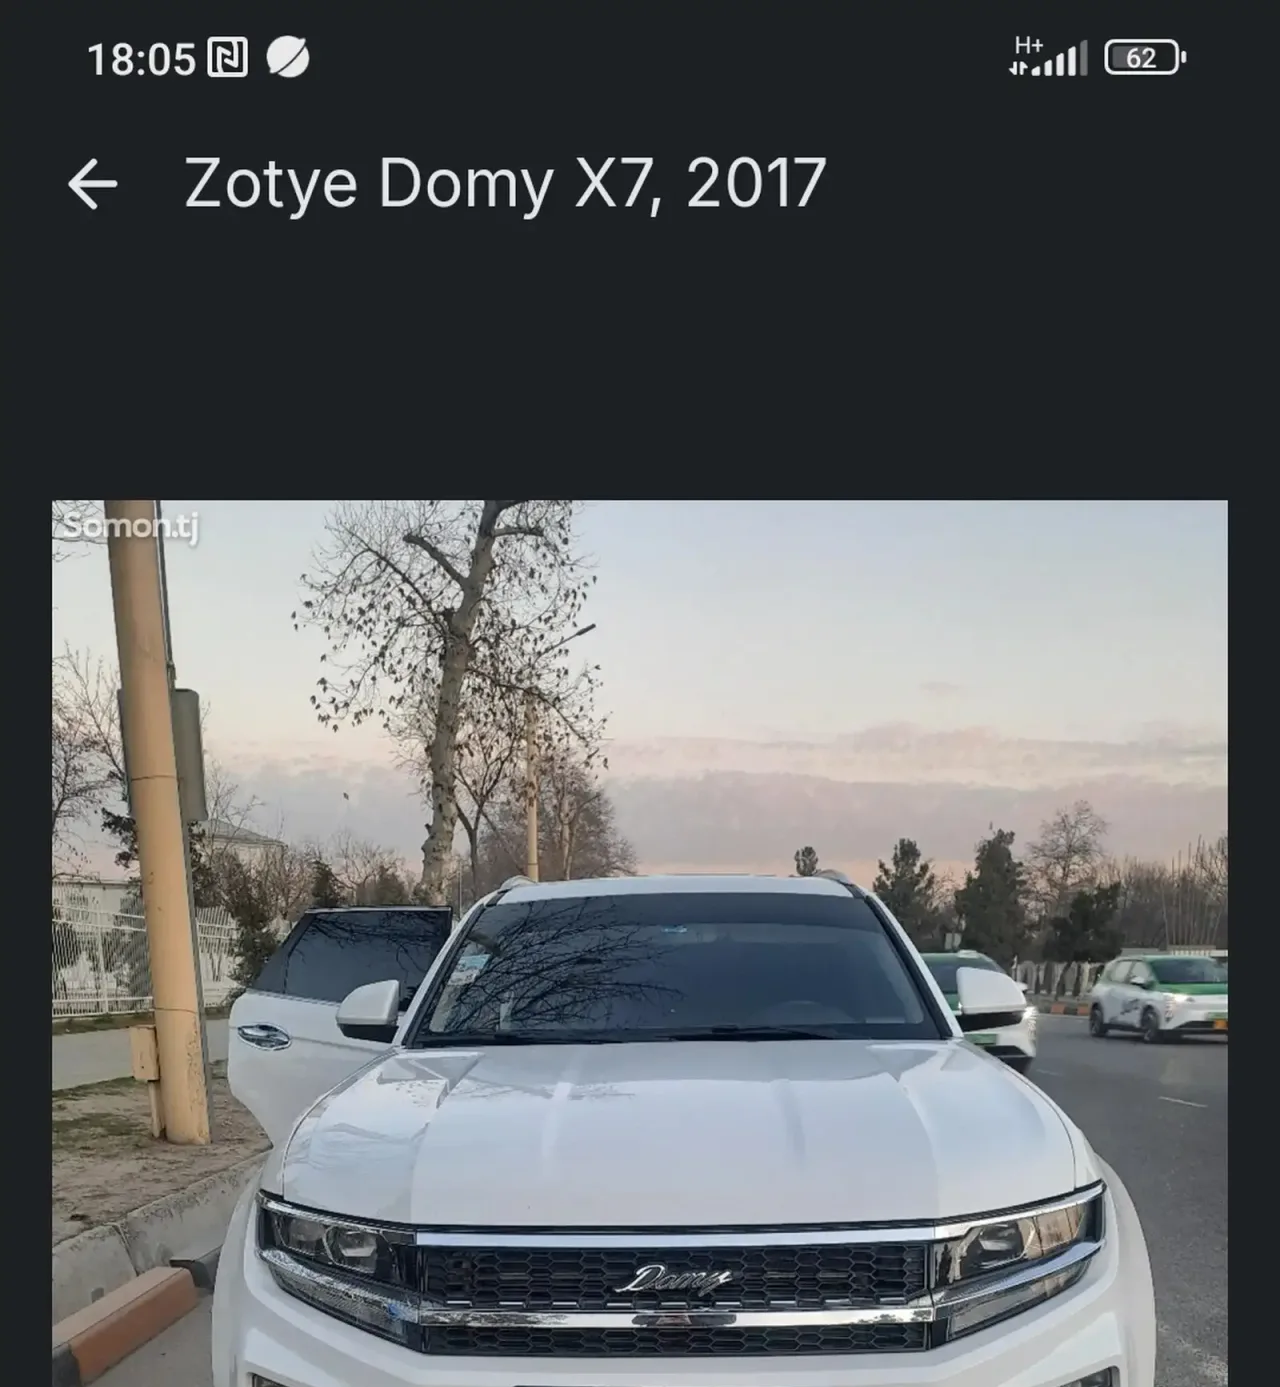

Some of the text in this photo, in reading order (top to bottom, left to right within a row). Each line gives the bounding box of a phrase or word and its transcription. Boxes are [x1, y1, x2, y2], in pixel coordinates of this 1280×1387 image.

[1015, 35, 1044, 55] H+
[1126, 47, 1157, 69] 62
[88, 42, 196, 77] 18:05
[185, 156, 827, 220] Zotye Domy X7, 2017
